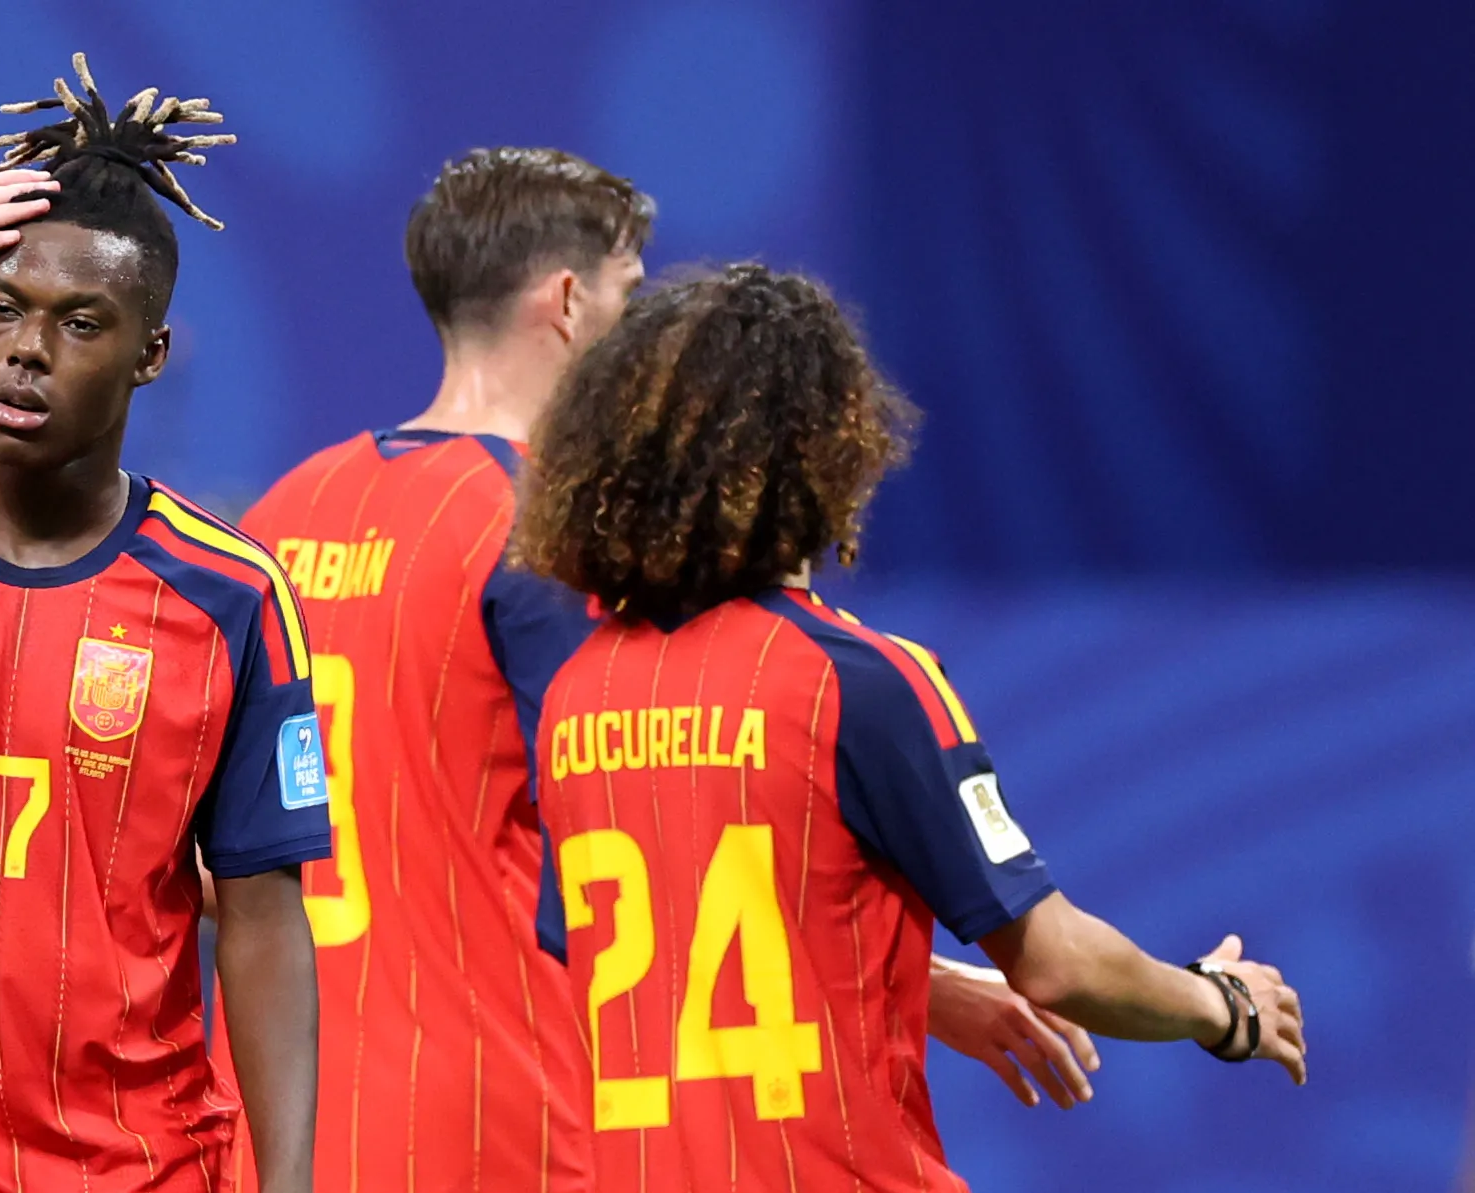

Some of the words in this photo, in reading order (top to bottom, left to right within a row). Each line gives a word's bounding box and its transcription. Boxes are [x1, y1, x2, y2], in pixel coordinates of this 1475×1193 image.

[276, 526, 395, 600] FABIÁN
[295, 768, 320, 787] PEACE
[551, 706, 765, 781] CUCURELLA
[559, 824, 822, 1132] 24
